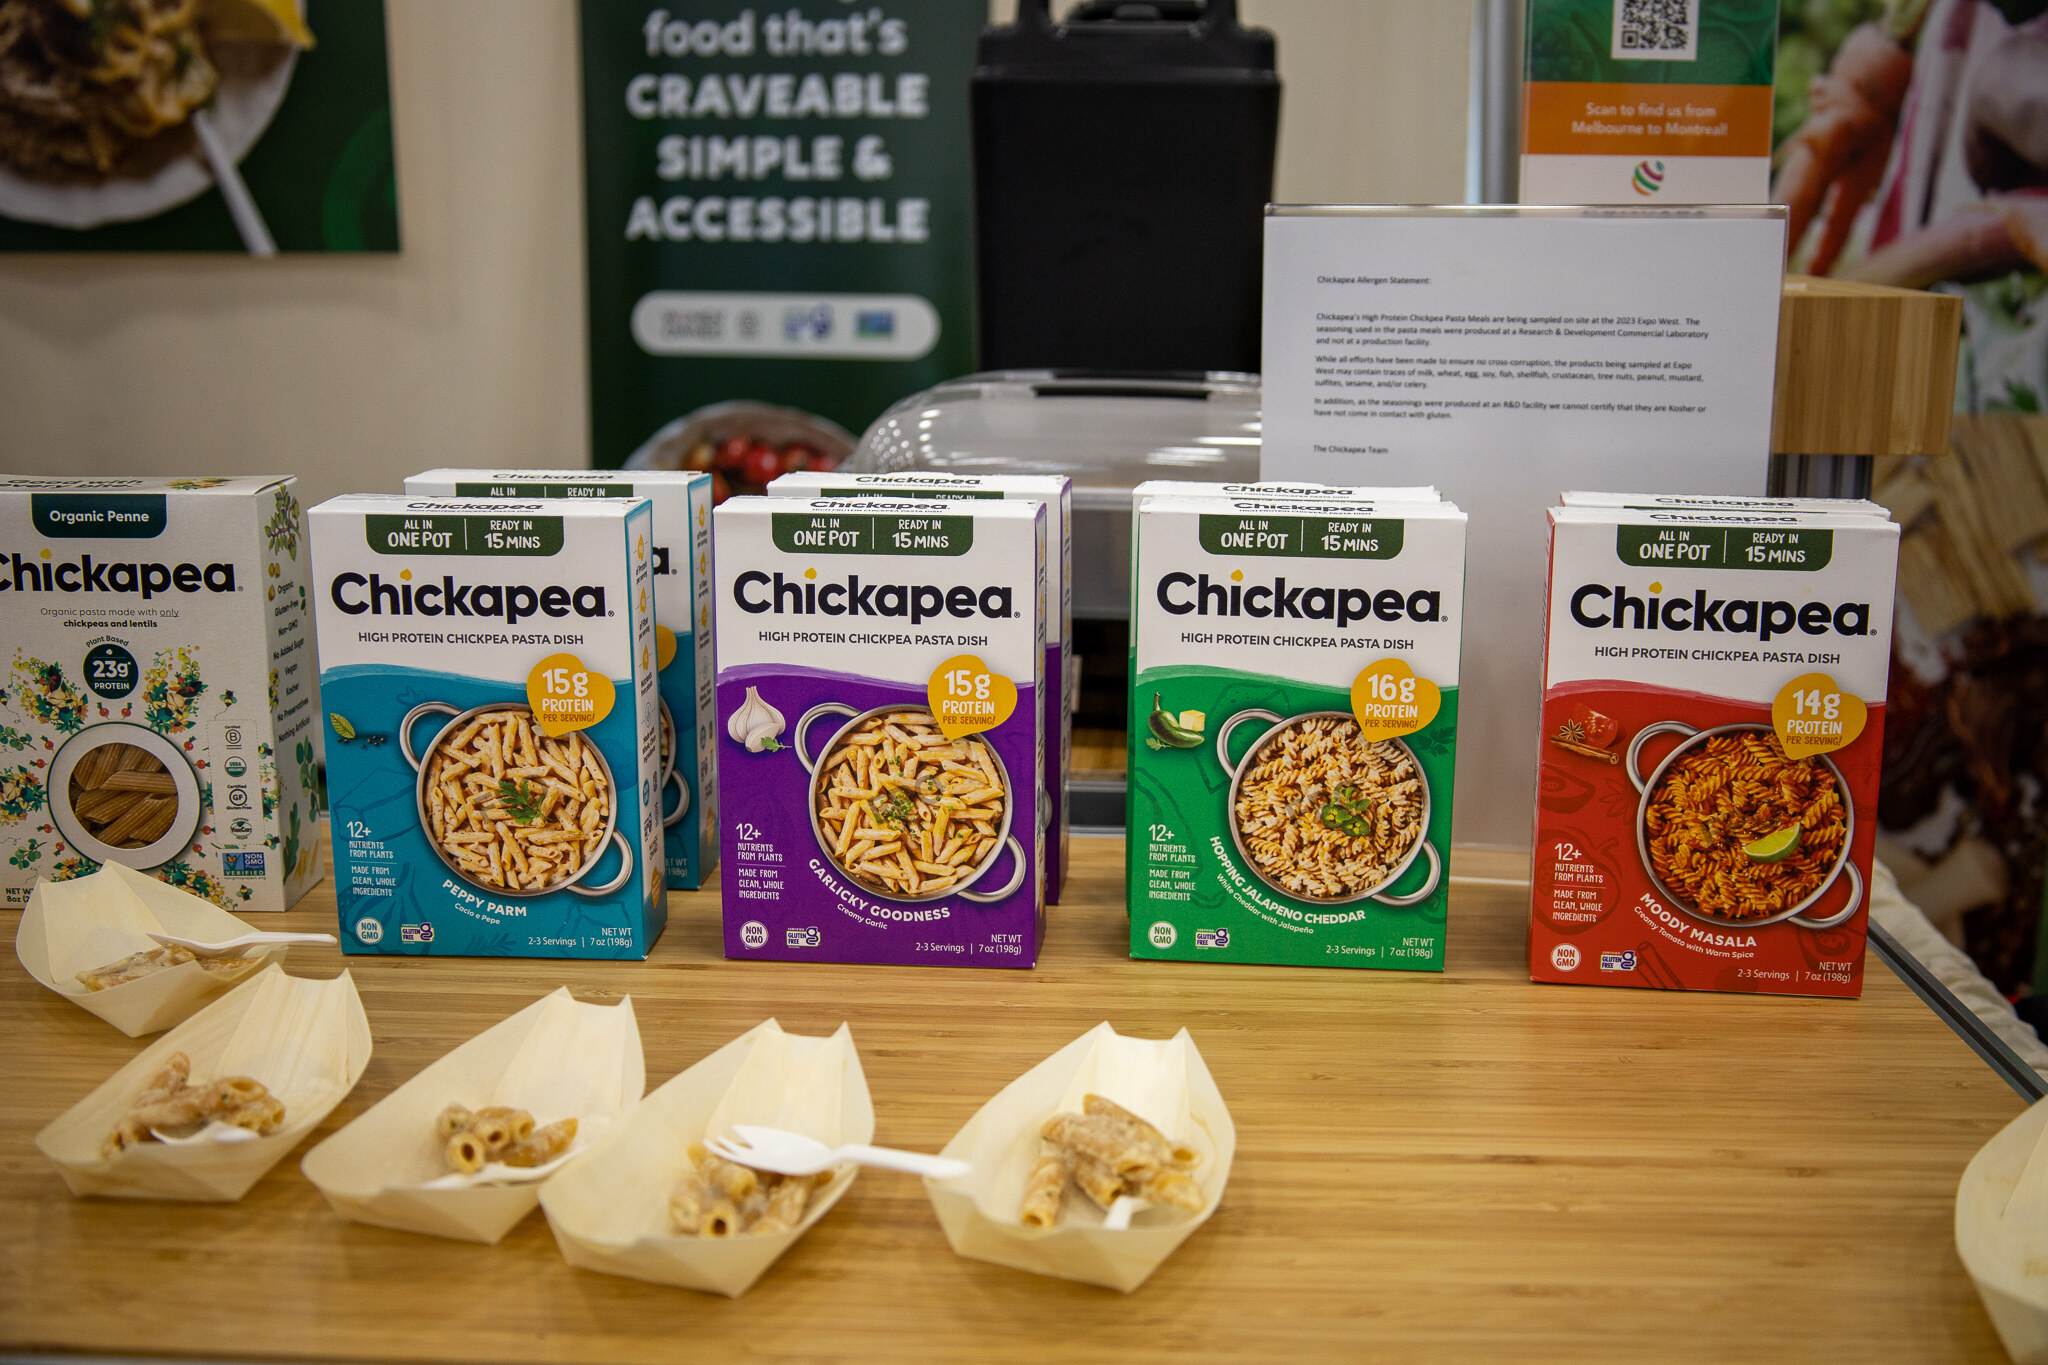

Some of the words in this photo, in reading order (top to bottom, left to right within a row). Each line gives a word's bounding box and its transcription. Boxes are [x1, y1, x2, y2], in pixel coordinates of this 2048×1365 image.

[643, 9, 755, 56] food
[764, 7, 907, 56] that's
[625, 73, 929, 118] CRAVEABLE
[1586, 102, 1617, 117] Scan
[1620, 104, 1634, 116] to
[1638, 102, 1664, 117] find
[1667, 106, 1682, 117] us
[1685, 103, 1716, 118] from
[1572, 120, 1644, 135] Melbourne
[1648, 123, 1662, 135] to
[1665, 122, 1728, 136] Montreal!
[657, 136, 842, 181] SIMPLE
[852, 136, 892, 180] &
[625, 196, 929, 243] ACCESSIBLE
[1317, 276, 1355, 285] Chickapea
[1357, 276, 1388, 285] Allergen
[1316, 313, 1360, 321] Chickapea's
[1362, 313, 1378, 322] High
[1410, 314, 1443, 322] Chickpea
[1507, 316, 1527, 324] being
[1530, 316, 1562, 324] sampled
[1638, 317, 1656, 325] Expo
[1564, 328, 1615, 337] Development
[1666, 330, 1709, 338] Laboratory
[1328, 445, 1366, 454] Chickapea
[50, 510, 104, 524] Organic
[107, 510, 149, 522] Penne
[404, 520, 420, 529] ALL
[423, 520, 432, 529] IN
[490, 520, 520, 530] READY
[523, 521, 532, 530] IN
[388, 532, 420, 547] ONE
[422, 533, 452, 548] POT
[484, 534, 504, 548] 15
[506, 536, 540, 549] MINS
[277, 580, 294, 595] Organic
[40, 608, 77, 617] Organic
[80, 609, 106, 617] pasta
[108, 608, 135, 616] made
[138, 608, 157, 616] with
[160, 608, 179, 617] only
[274, 599, 299, 617] Gluten-Free
[63, 620, 109, 629] chickpeas
[278, 619, 298, 637] Non-GMO
[86, 636, 105, 648] Plant
[106, 635, 129, 646] Based
[358, 632, 389, 642] HIGH
[392, 633, 443, 643] PROTEIN
[446, 634, 509, 644] CHICKPEA
[512, 635, 550, 644] PASTA
[554, 635, 584, 644] DISH
[759, 632, 790, 642] HIGH
[793, 632, 846, 643] PROTEIN
[848, 634, 912, 644] CHICKPEA
[915, 635, 954, 645] PASTA
[958, 636, 988, 646] DISH
[1181, 633, 1214, 643] HIGH
[1216, 634, 1270, 646] PROTEIN
[1273, 636, 1337, 647] CHICKPEA
[1340, 638, 1380, 648] PASTA
[1384, 639, 1414, 649] DISH
[1595, 646, 1628, 657] HIGH
[1632, 648, 1688, 660] PROTEIN
[1692, 650, 1759, 661] CHICKPEA
[1762, 652, 1804, 662] PASTA
[1807, 653, 1840, 664] DISH
[284, 662, 298, 676] Vegan
[542, 668, 588, 697] 15g
[944, 670, 990, 699] 15g
[1368, 674, 1416, 703] 16g
[542, 698, 593, 712] PROTEIN
[942, 700, 994, 714] PROTEIN
[1366, 704, 1418, 718] PROTEIN
[1793, 689, 1840, 719] 14g
[561, 714, 595, 722] SERVING!
[943, 716, 957, 724] PER
[960, 716, 996, 725] SERVING!
[1365, 719, 1379, 727] PER
[1383, 720, 1418, 728] SERVING!
[1787, 719, 1843, 734] PROTEIN
[1786, 736, 1801, 744] PER
[1805, 736, 1842, 746] SERVING!
[347, 821, 372, 838] 12+
[349, 841, 384, 850] NUTRIENTS
[350, 850, 367, 858] FROM
[370, 850, 393, 859] PLANTS
[1209, 836, 1246, 887] HOPPING
[1304, 910, 1366, 924] CHEDDAR
[442, 879, 485, 908] PEPPY
[487, 902, 527, 916] PARM
[809, 859, 869, 911] GARLICKY
[870, 905, 950, 922] GOODNESS
[837, 903, 864, 923] Creamy
[865, 918, 888, 930] Garlic
[1640, 892, 1690, 934] MOODY
[1690, 928, 1757, 947] MASALA
[916, 943, 929, 951] 2-3
[930, 943, 964, 952] Servings
